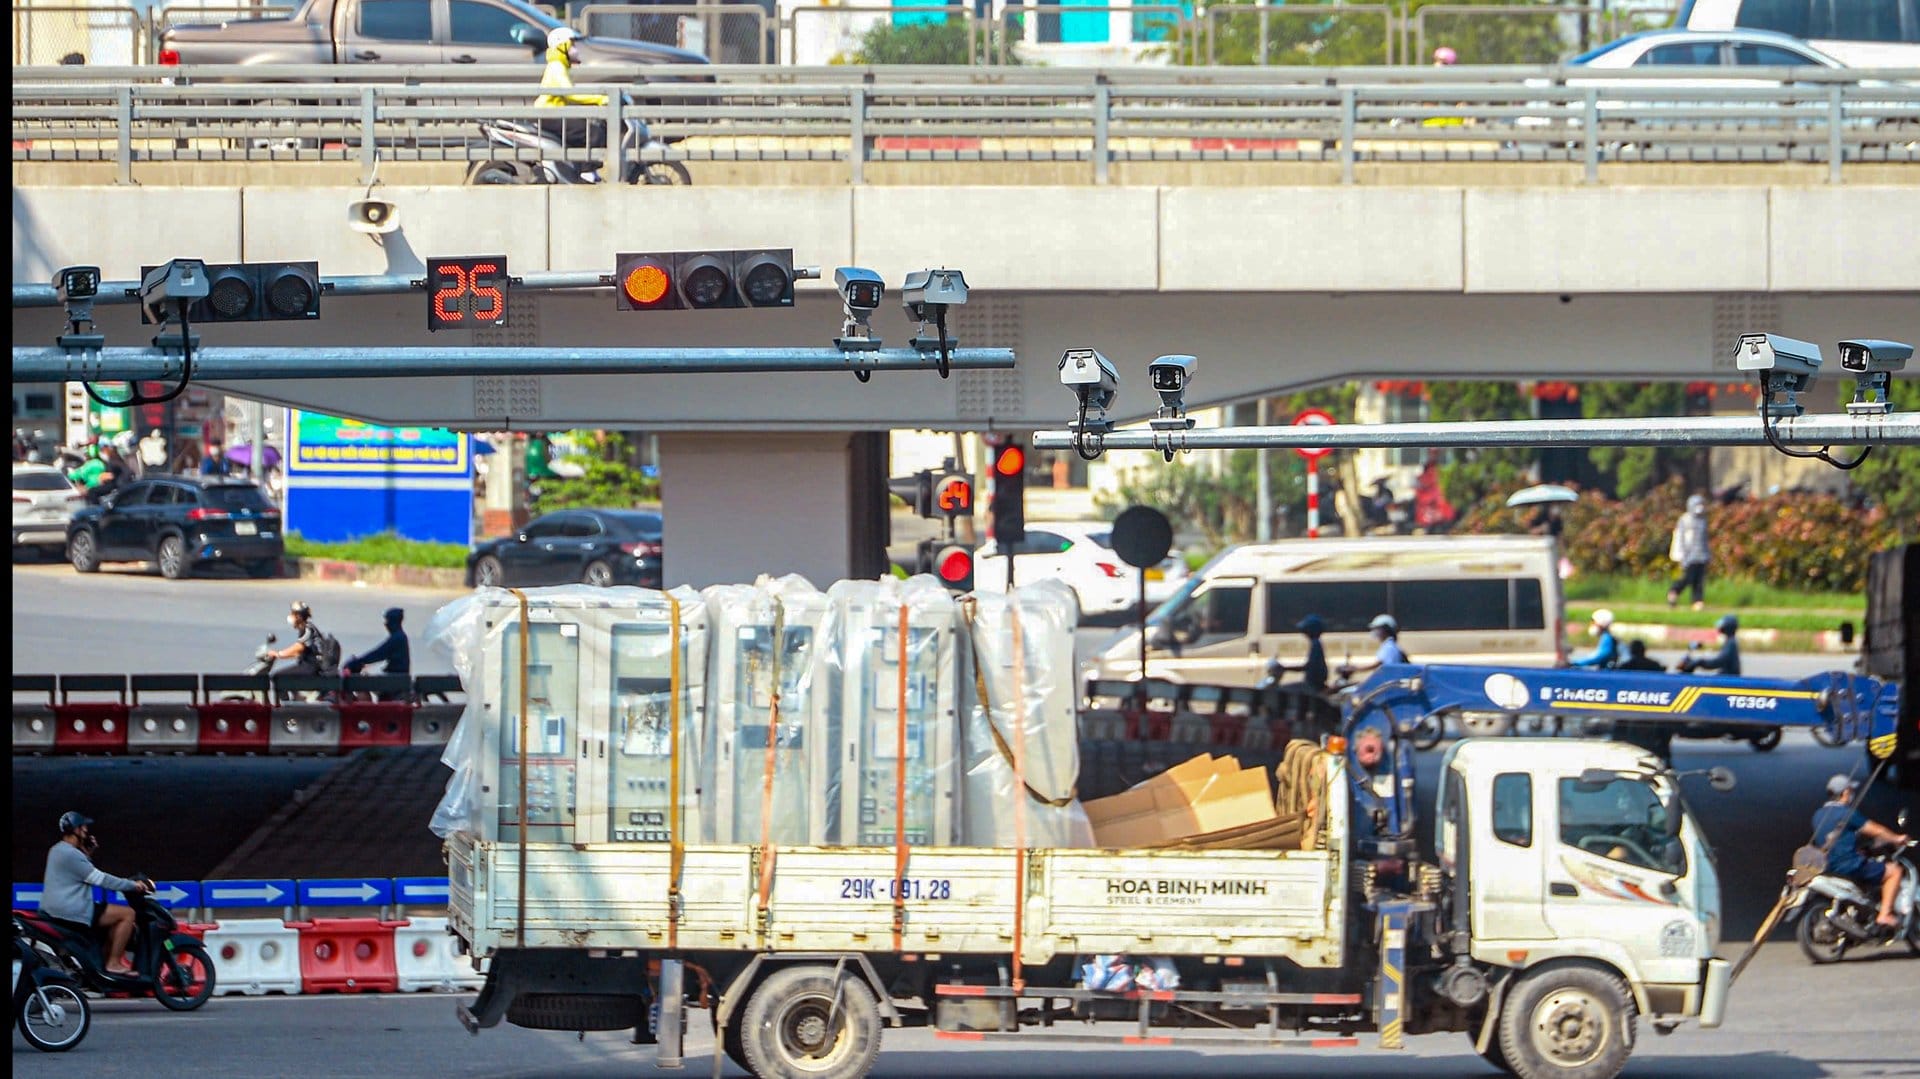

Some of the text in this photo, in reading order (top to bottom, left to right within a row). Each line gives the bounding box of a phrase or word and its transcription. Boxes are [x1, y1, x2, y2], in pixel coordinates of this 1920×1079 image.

[434, 264, 503, 321] 25
[1617, 690, 1671, 705] CRANE
[1106, 879, 1268, 896] HOA BINH MINH
[1107, 896, 1141, 905] STEEL
[1155, 896, 1203, 906] CEMENT
